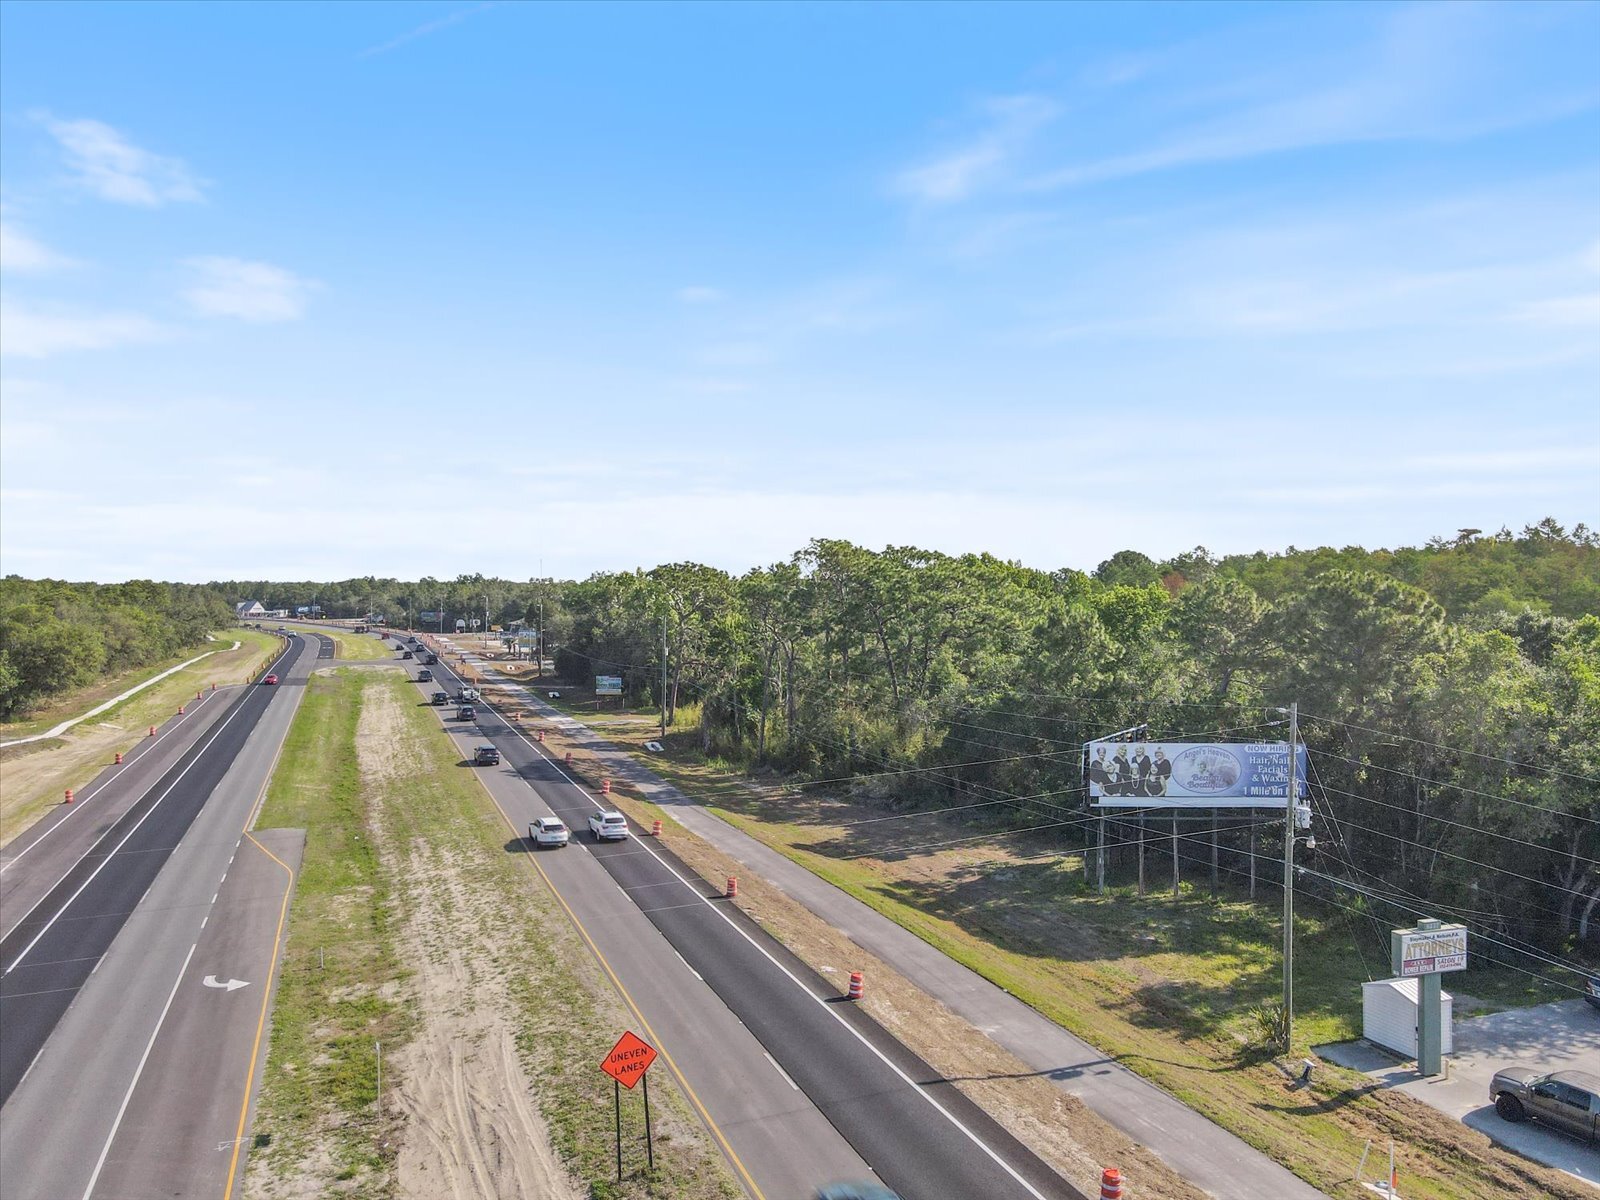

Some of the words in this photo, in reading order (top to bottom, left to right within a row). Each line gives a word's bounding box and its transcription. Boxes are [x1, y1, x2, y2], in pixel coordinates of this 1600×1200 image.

[1272, 756, 1290, 764] Nail
[1258, 765, 1288, 773] Facials
[1251, 774, 1259, 782] &
[1261, 774, 1290, 782] Waxin
[1251, 786, 1270, 795] Mile
[1405, 938, 1465, 960] ATTORNEYS
[610, 1047, 647, 1064] UNEVEN
[614, 1060, 645, 1076] LANES
